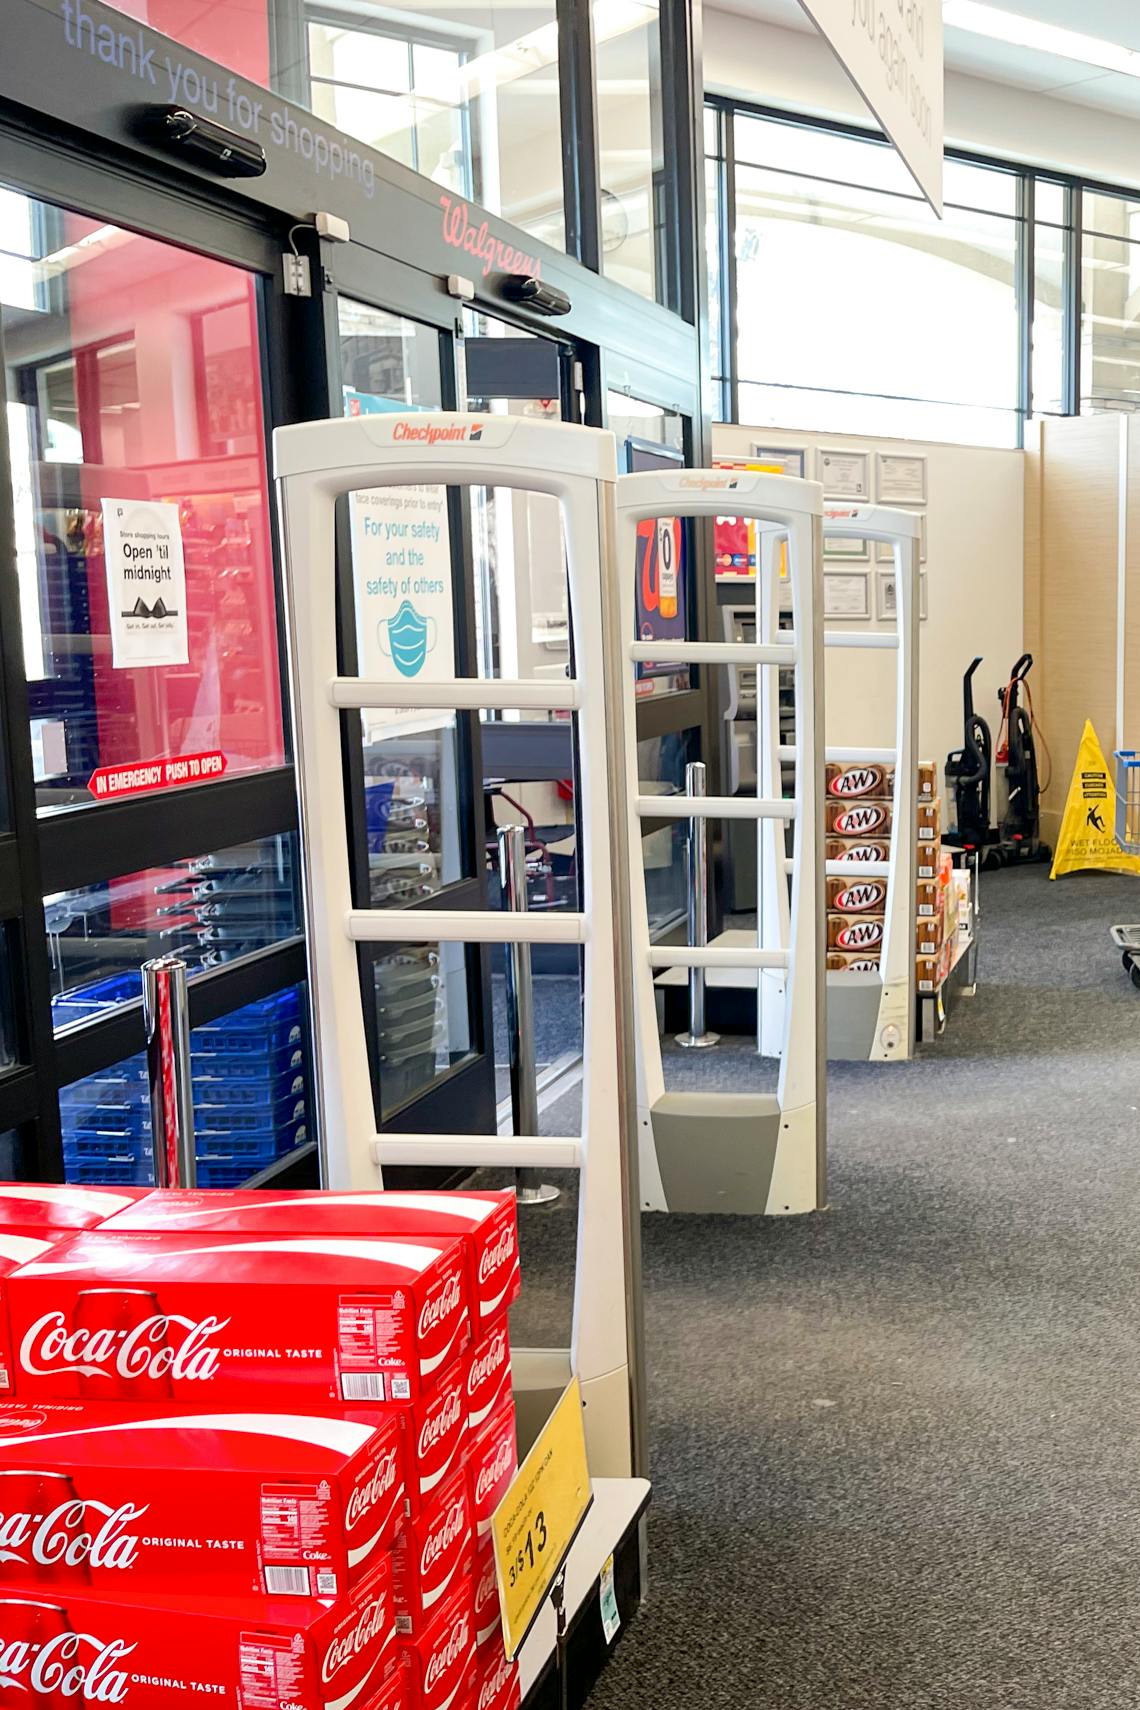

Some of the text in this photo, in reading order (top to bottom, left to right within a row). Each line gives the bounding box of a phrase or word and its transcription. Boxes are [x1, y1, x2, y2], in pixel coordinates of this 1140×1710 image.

[61, 0, 376, 199] thank you for shopping
[440, 195, 542, 277] Walgreens
[393, 422, 467, 444] Checkpoint
[123, 543, 168, 561] Open 'til
[364, 516, 440, 543] For your safety
[124, 565, 172, 583] midnight
[386, 547, 424, 566] and the
[367, 577, 444, 598] safety of others
[96, 756, 222, 794] IN EMERGENCY PUSH TO OPEN
[1071, 839, 1089, 848] WET
[479, 1223, 515, 1284] Coca-Cola
[418, 1269, 462, 1339] Coca-Cola
[20, 1311, 232, 1380] Coca-Cola
[223, 1348, 322, 1359] ORIGINAL TASTE
[378, 1357, 402, 1367] Coke
[468, 1328, 507, 1396] Coca-Cola
[32, 1404, 84, 1412] ORIGINAL
[418, 1383, 462, 1459] Coca-Cola
[345, 1445, 398, 1532] Coca-Cola
[476, 1434, 513, 1505] Coca-Cola
[0, 1499, 150, 1569] a-Cola
[142, 1537, 245, 1550] ORIGINAL TASTE
[303, 1551, 328, 1560] Coke
[421, 1495, 465, 1575] Coca-Cola
[322, 1590, 388, 1684] Coca-Cola
[424, 1610, 470, 1694] Coca-Cola
[0, 1632, 139, 1704] a-Cola
[131, 1673, 187, 1690] ORIGINAL
[190, 1681, 226, 1695] TASTE
